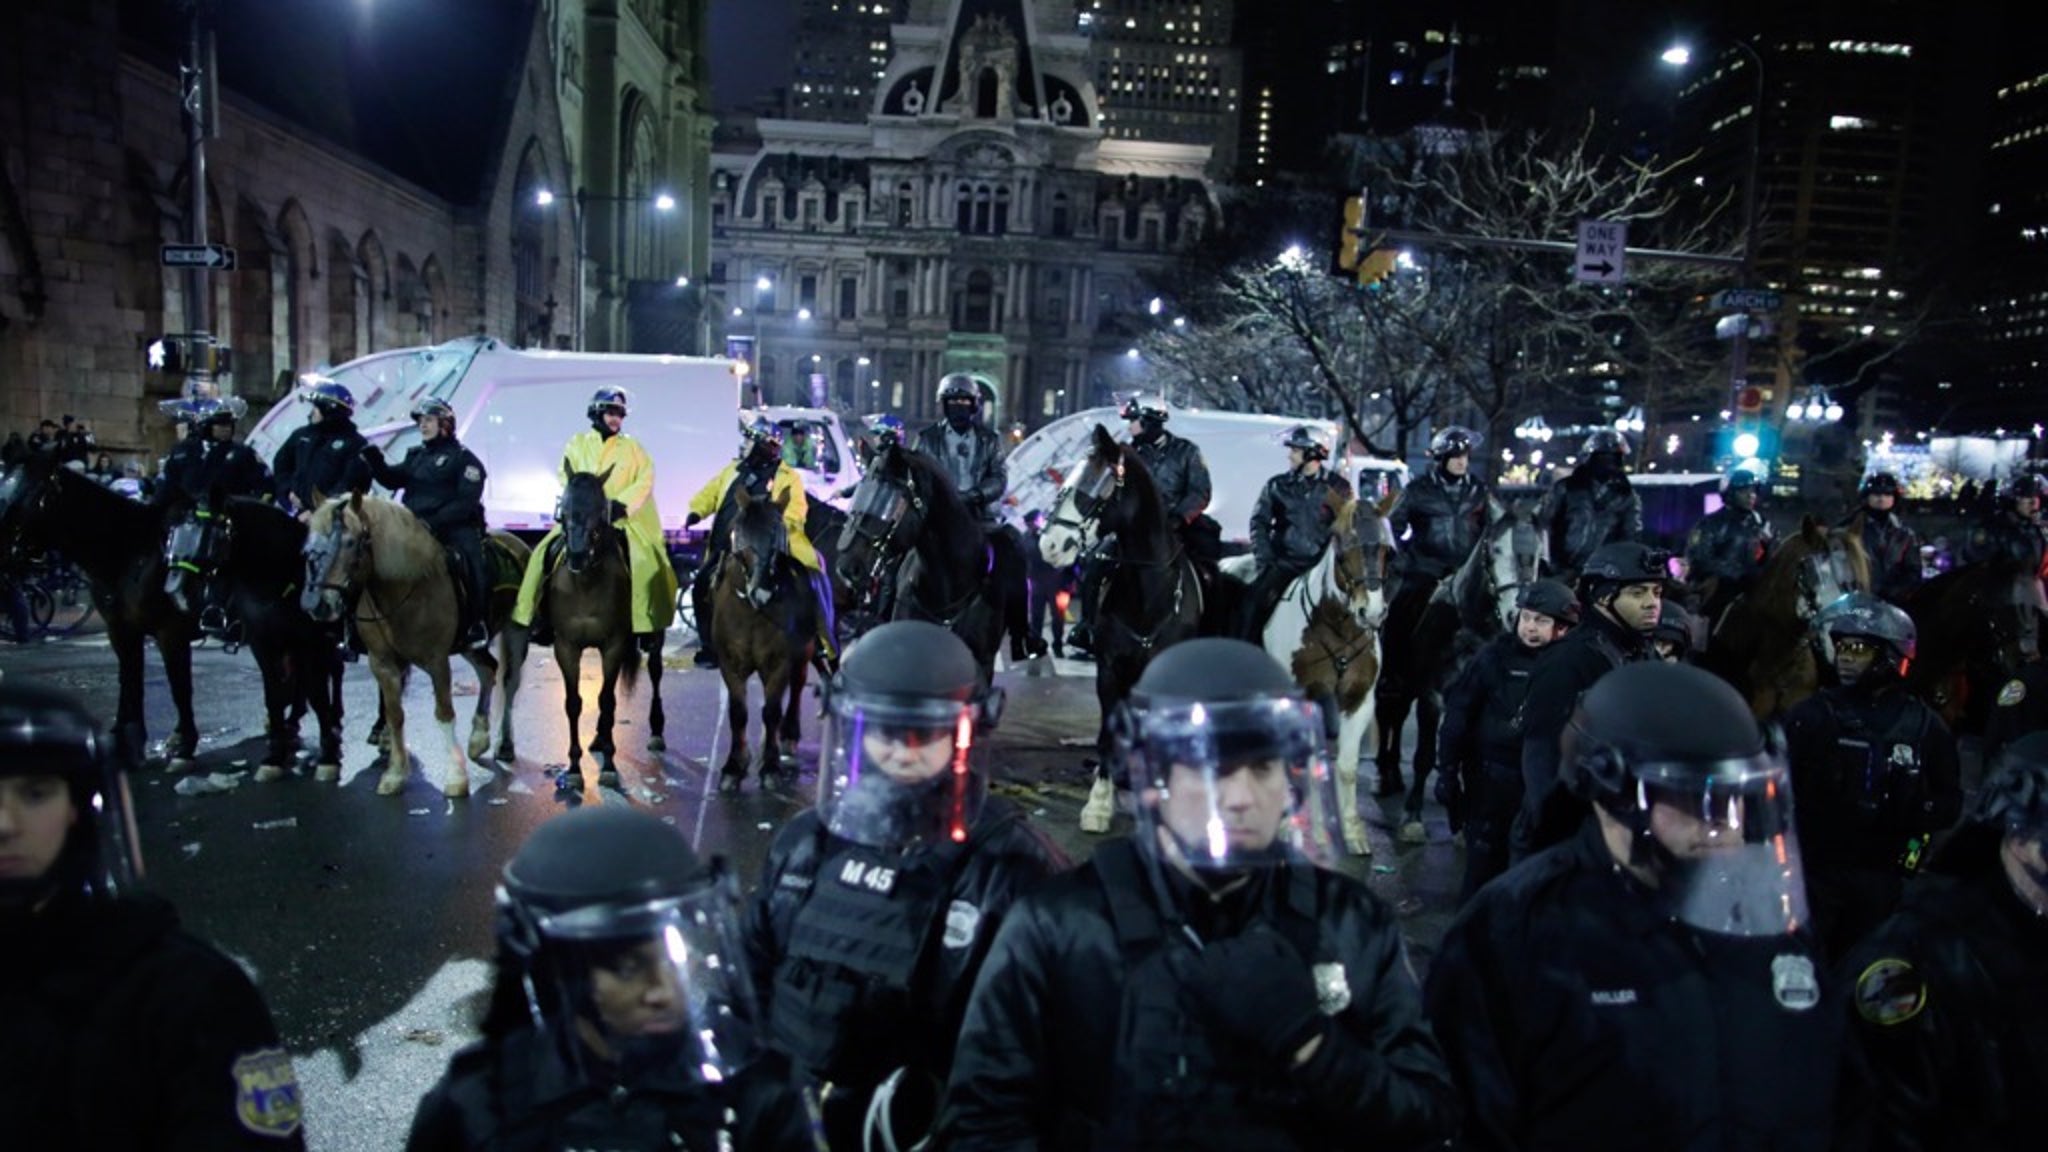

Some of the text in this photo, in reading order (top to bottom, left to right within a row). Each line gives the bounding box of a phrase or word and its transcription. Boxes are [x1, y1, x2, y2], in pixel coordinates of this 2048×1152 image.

[1586, 226, 1616, 241] ONE
[1585, 242, 1617, 257] WAY
[1725, 292, 1764, 308] ARCH
[840, 859, 866, 885] M
[864, 866, 896, 893] 45
[1591, 990, 1637, 1004] MILLER
